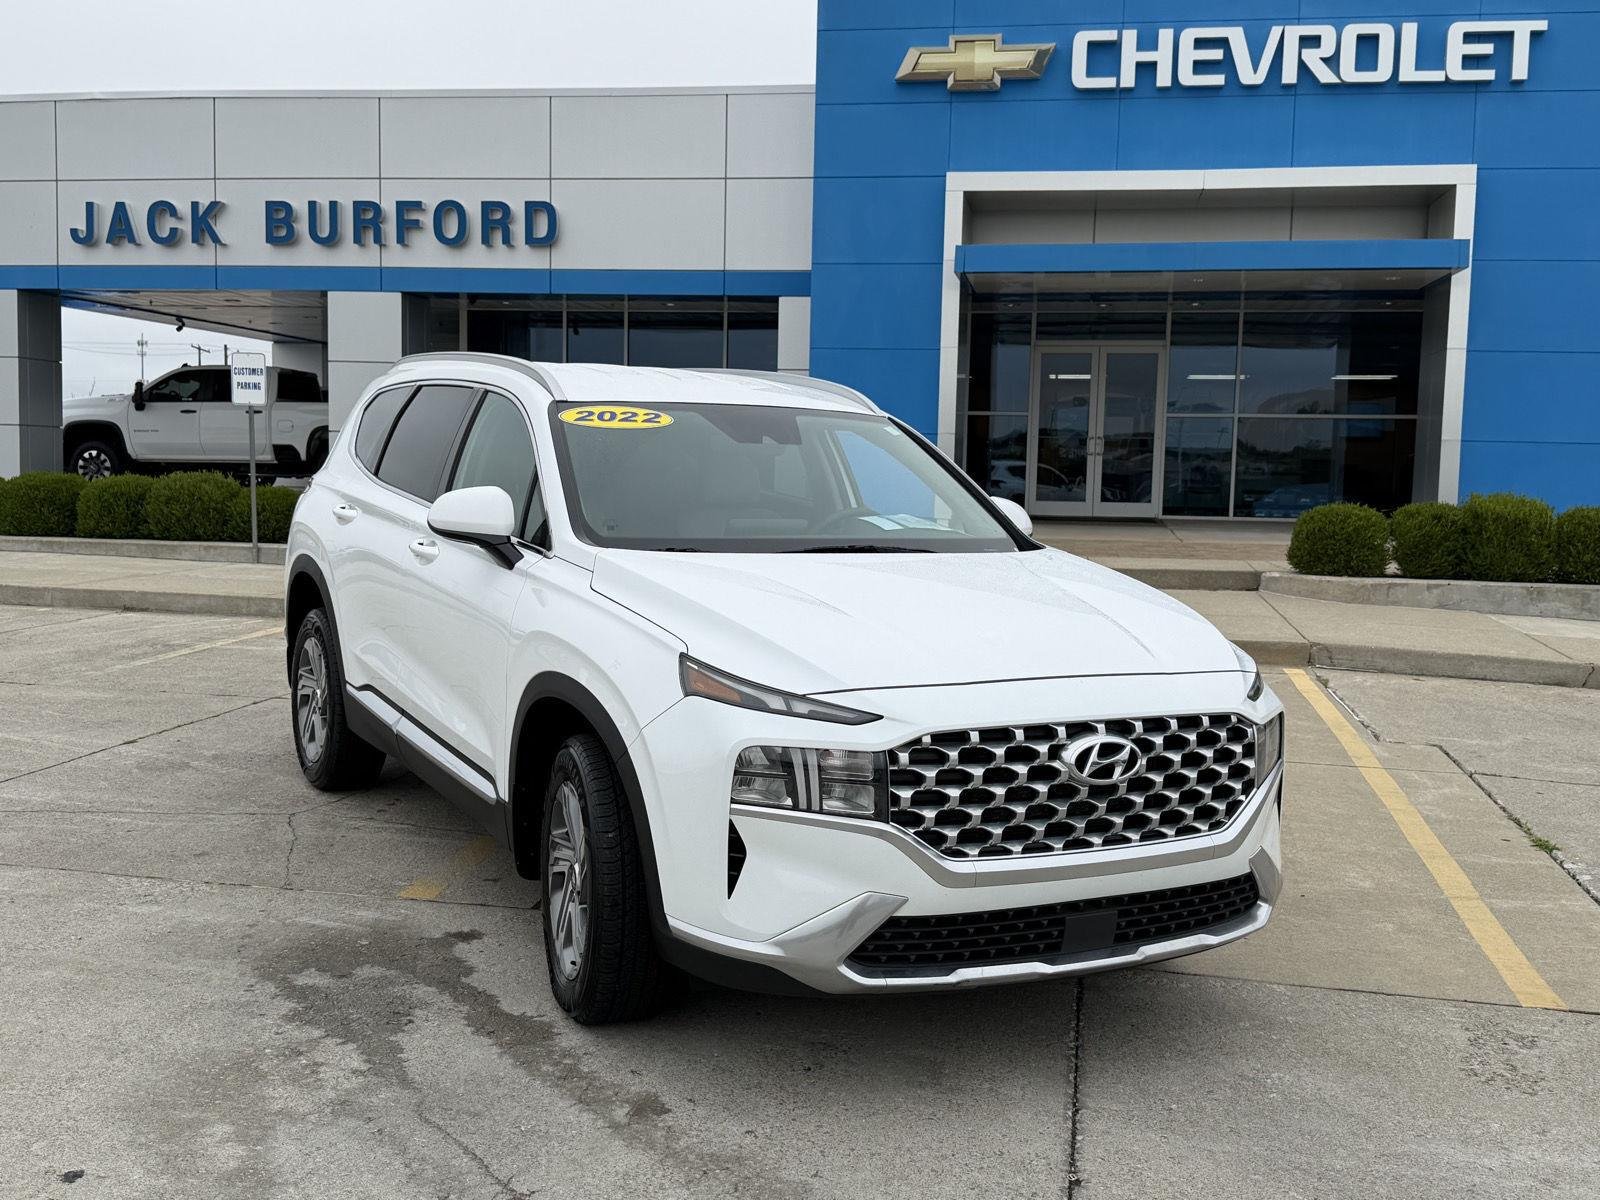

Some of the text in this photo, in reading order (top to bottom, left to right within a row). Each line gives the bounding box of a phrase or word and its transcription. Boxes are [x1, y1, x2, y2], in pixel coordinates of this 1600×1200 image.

[1071, 19, 1549, 90] CHEVROLET
[69, 199, 559, 248] JACK BURFORD
[233, 366, 264, 376] CUSTOMER
[236, 381, 262, 391] PARKING
[573, 410, 662, 424] 2022
